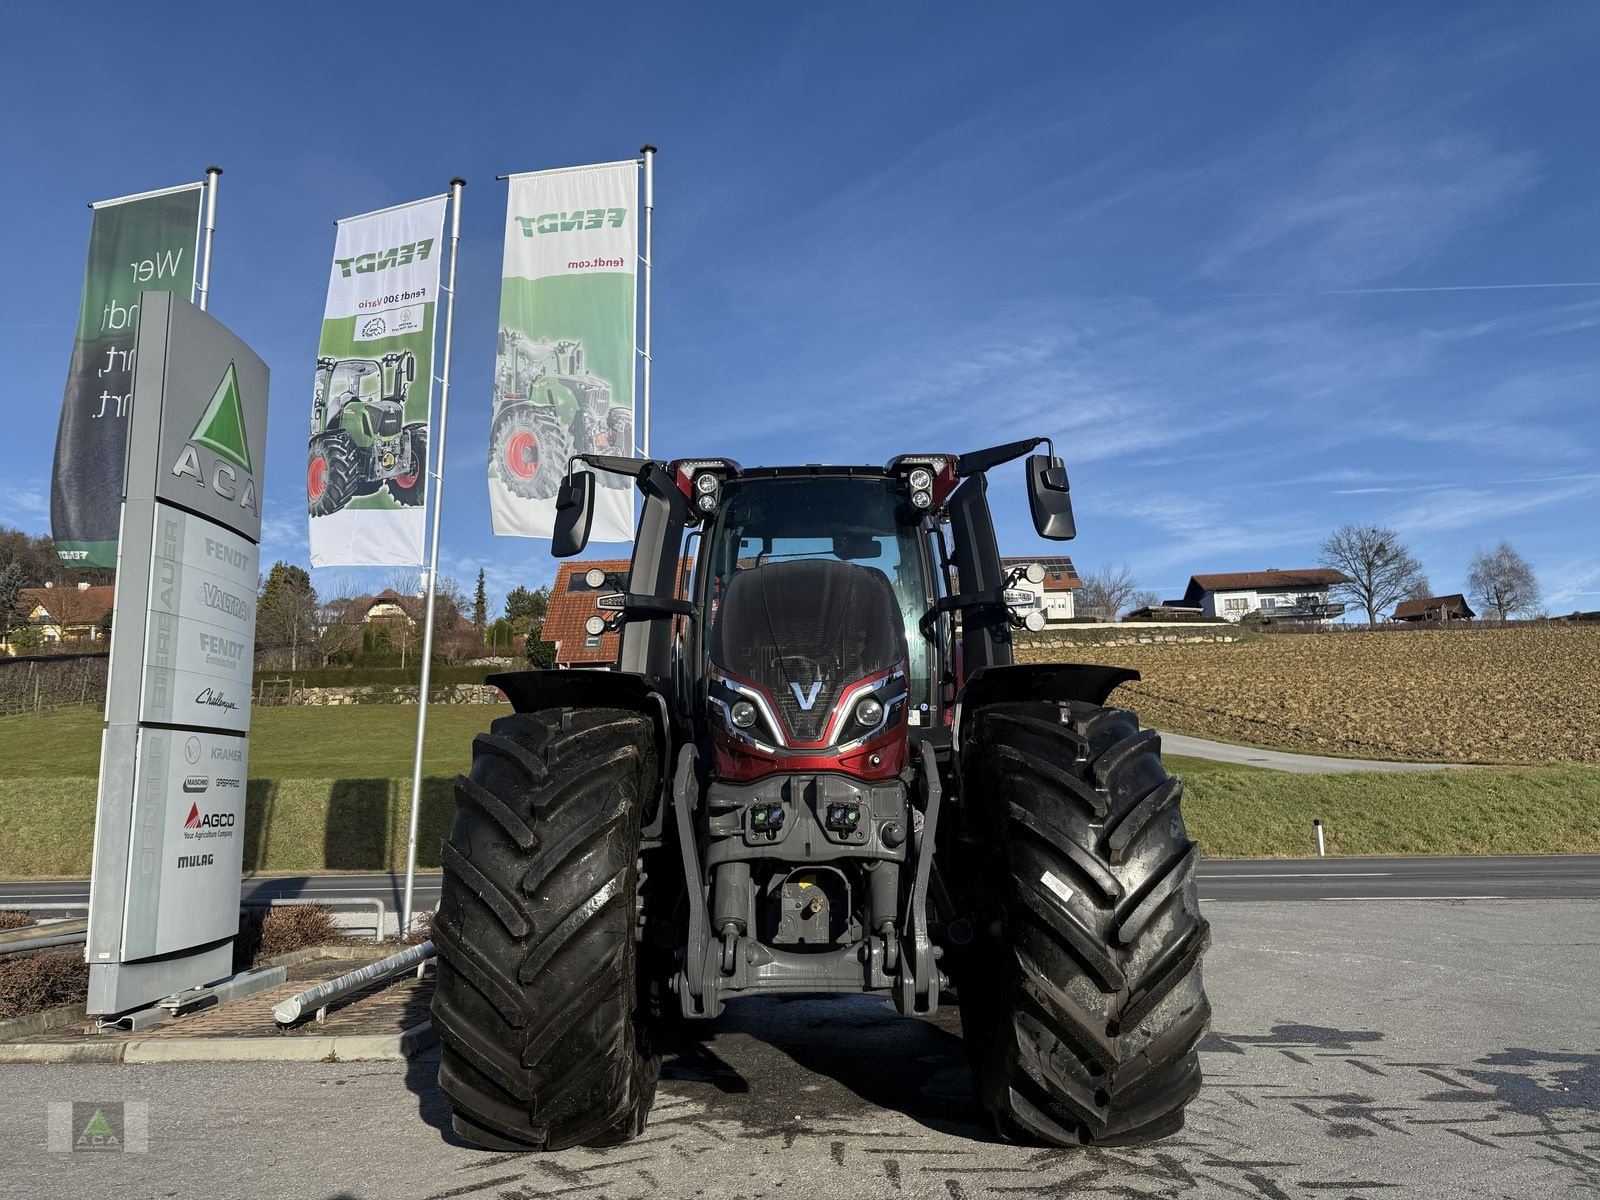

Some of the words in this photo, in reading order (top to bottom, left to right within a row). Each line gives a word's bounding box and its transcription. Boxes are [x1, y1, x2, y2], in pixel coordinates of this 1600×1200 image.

[171, 443, 258, 518] ACA
[205, 537, 249, 572] FENDT
[203, 582, 248, 622] VALTRA
[200, 632, 245, 661] FENDT
[195, 687, 240, 714] Challenger
[211, 747, 242, 763] KRAMER
[186, 778, 209, 786] MASCHIO
[202, 813, 235, 828] AGCO
[184, 831, 194, 840] Your
[195, 830, 217, 841] Agriculture
[177, 853, 214, 868] MULAG
